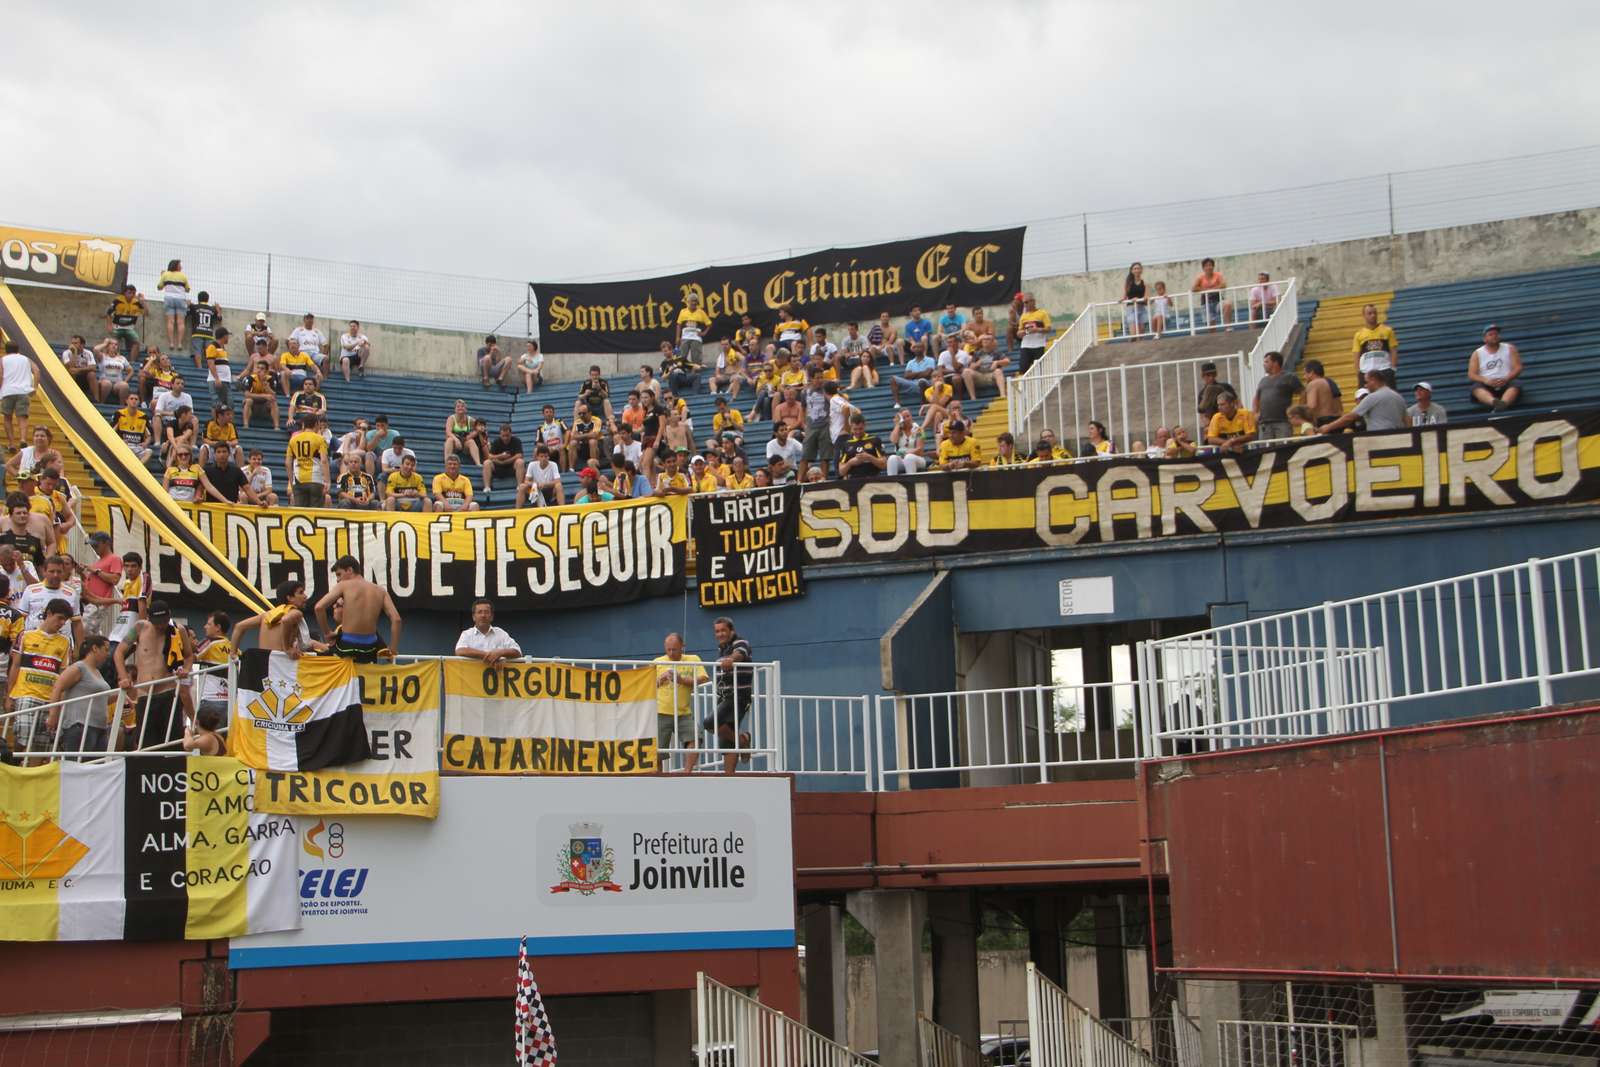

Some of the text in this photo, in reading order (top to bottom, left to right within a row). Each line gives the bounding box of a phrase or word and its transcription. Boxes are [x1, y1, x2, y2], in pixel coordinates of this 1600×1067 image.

[549, 292, 673, 332] Somente
[297, 440, 311, 458] 10
[800, 419, 1581, 560] SOU CARVOEIRO
[709, 492, 785, 525] LARGO
[225, 512, 418, 600] DESTINO
[430, 514, 455, 597] É
[466, 516, 517, 597] TE
[525, 504, 675, 595] SEGUIR
[720, 522, 777, 553] TUDO
[711, 546, 784, 579] E VOU
[700, 570, 799, 606] CONTIGO!
[1063, 580, 1073, 614] SETOR
[482, 666, 622, 701] ORGULHO
[255, 721, 289, 730] CRICIUMA
[446, 734, 655, 772] CATARINENSE
[140, 771, 220, 794] NOSSO
[265, 772, 430, 806] TRICOLOR
[160, 801, 188, 820] DE
[141, 818, 296, 853] ALMA, GARRA
[633, 831, 745, 855] Prefeitura de
[140, 858, 272, 891] E CORAÇÃO
[298, 868, 369, 899] ELEJ
[629, 856, 745, 890] Joinville
